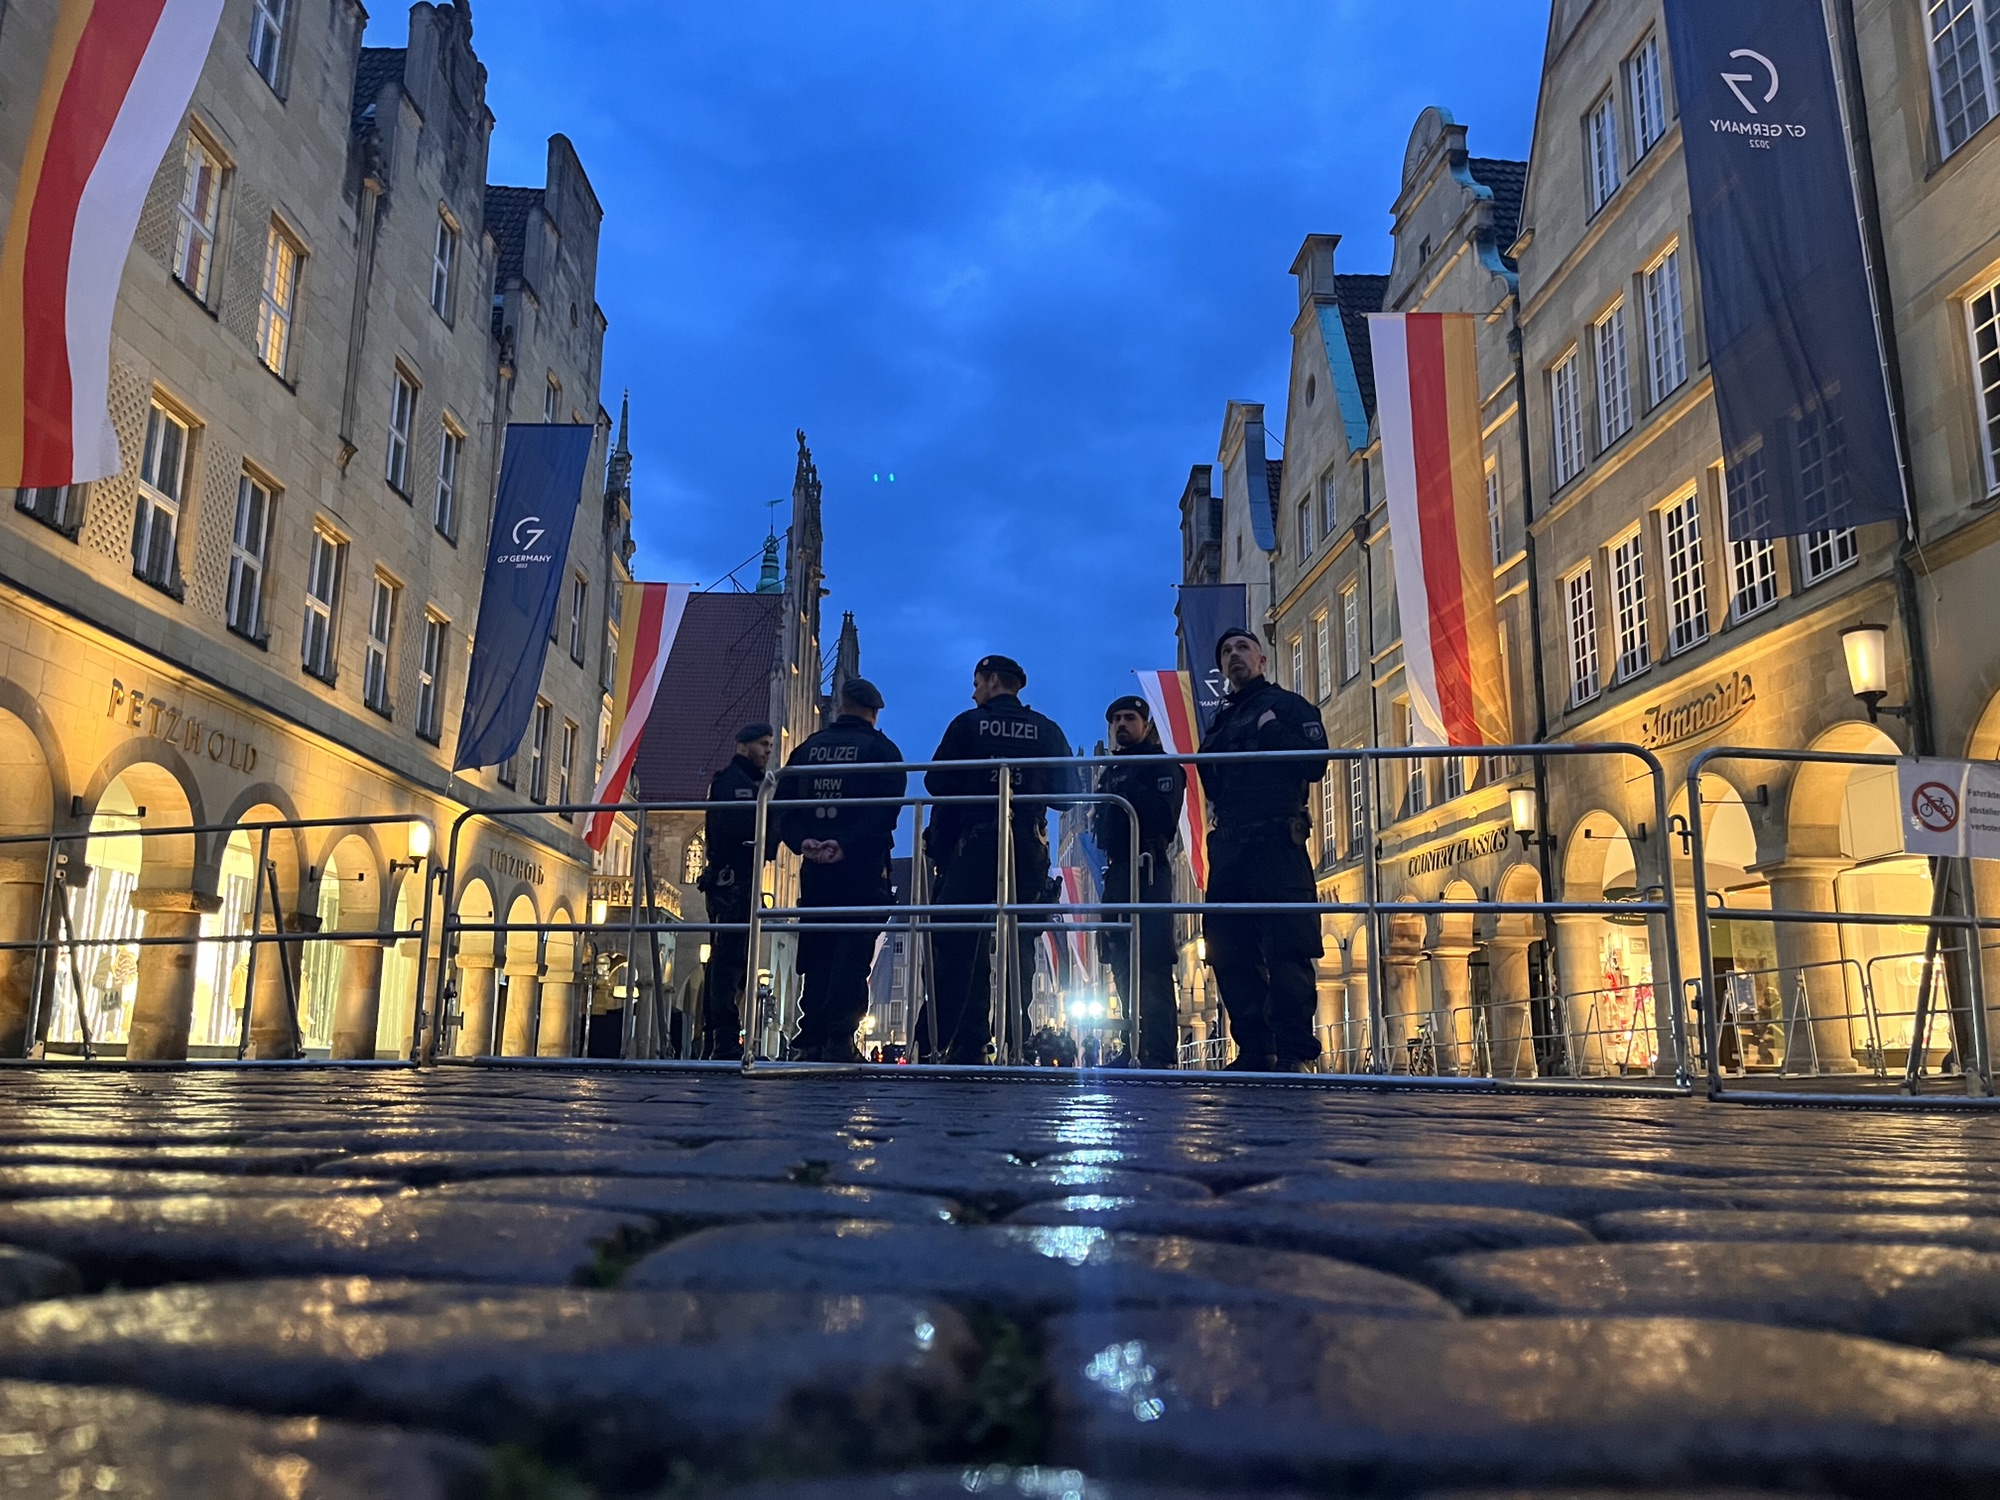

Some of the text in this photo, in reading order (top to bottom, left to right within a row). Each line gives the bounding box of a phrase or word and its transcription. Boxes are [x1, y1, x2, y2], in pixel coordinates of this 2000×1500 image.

[497, 554, 552, 564] G7 GERMANY
[106, 677, 258, 775] PETZHOLD
[980, 720, 1038, 740] POLIZEI
[808, 746, 859, 761] POLIZEI
[813, 778, 843, 790] NRW
[1408, 826, 1509, 878] COUNTRY CLASSICS
